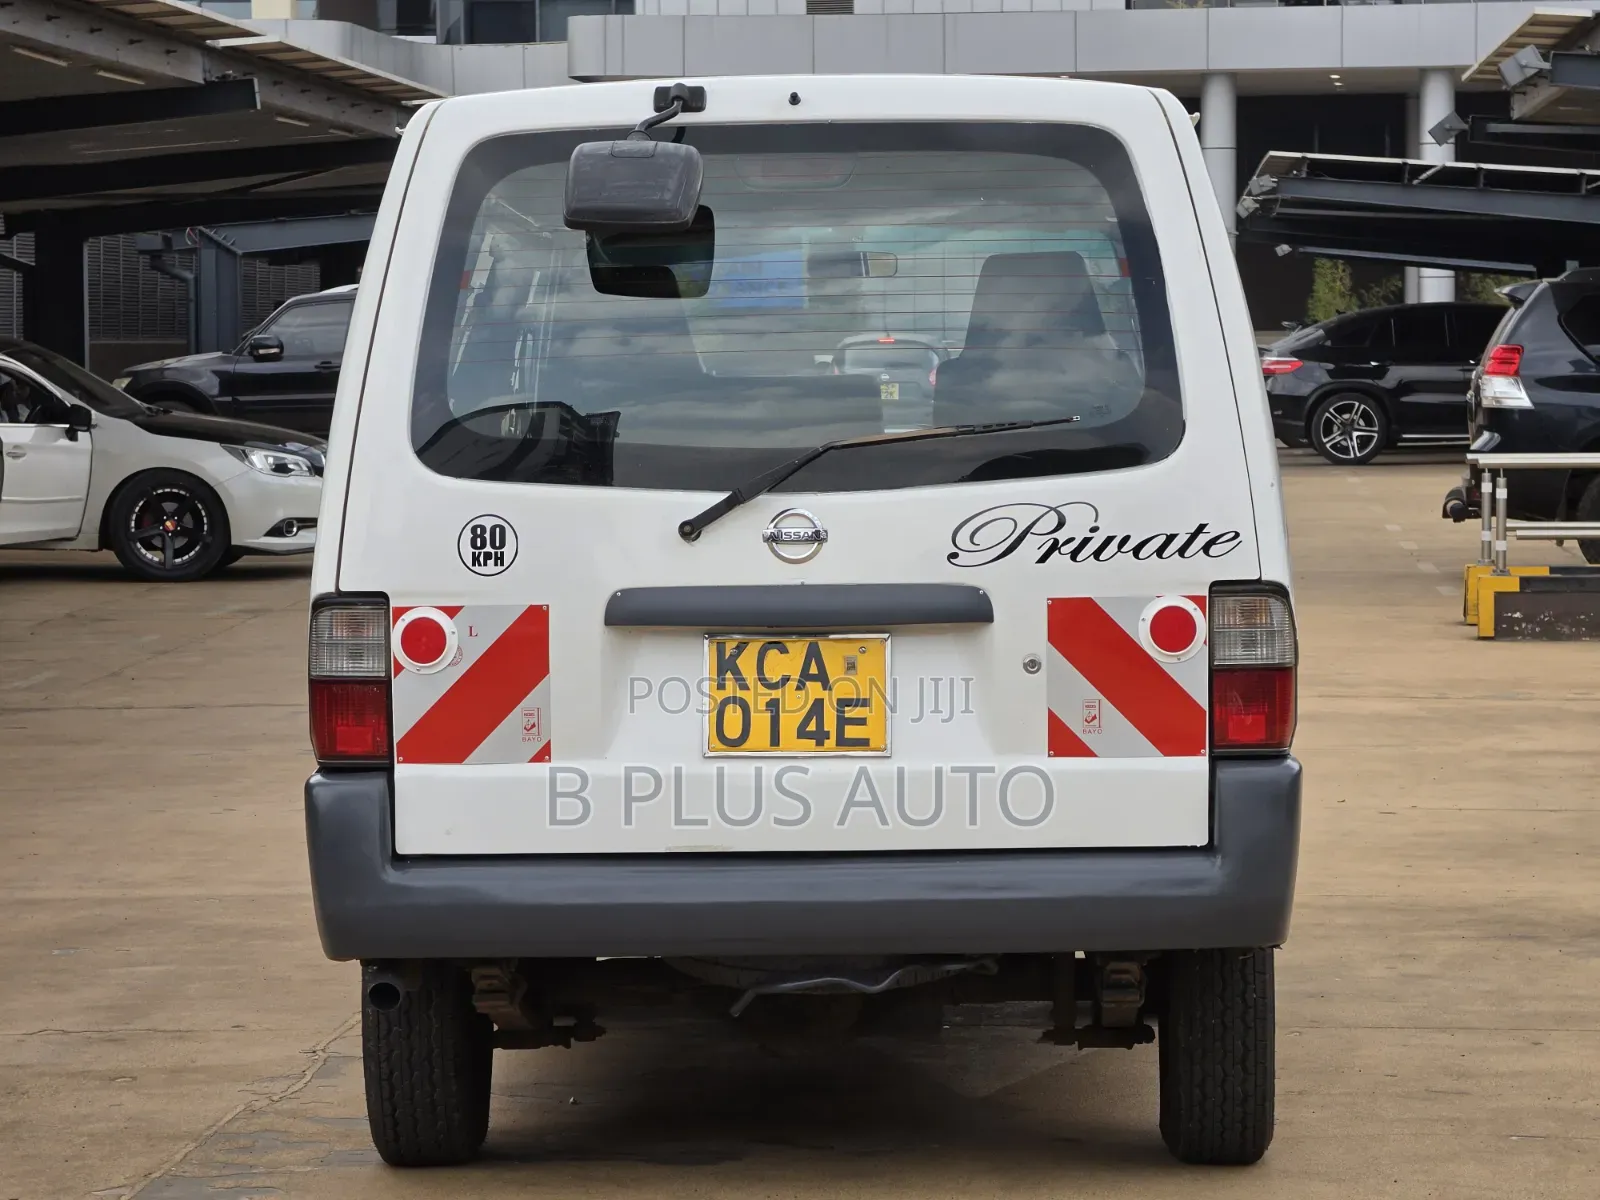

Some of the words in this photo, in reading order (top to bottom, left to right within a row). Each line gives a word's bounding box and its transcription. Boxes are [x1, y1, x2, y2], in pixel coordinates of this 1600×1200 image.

[470, 523, 506, 550] 80
[768, 530, 821, 541] NISSAN
[946, 501, 1242, 568] Private
[471, 550, 505, 567] KPH
[467, 624, 479, 638] L
[715, 641, 831, 691] KCA
[715, 696, 871, 748] 014E
